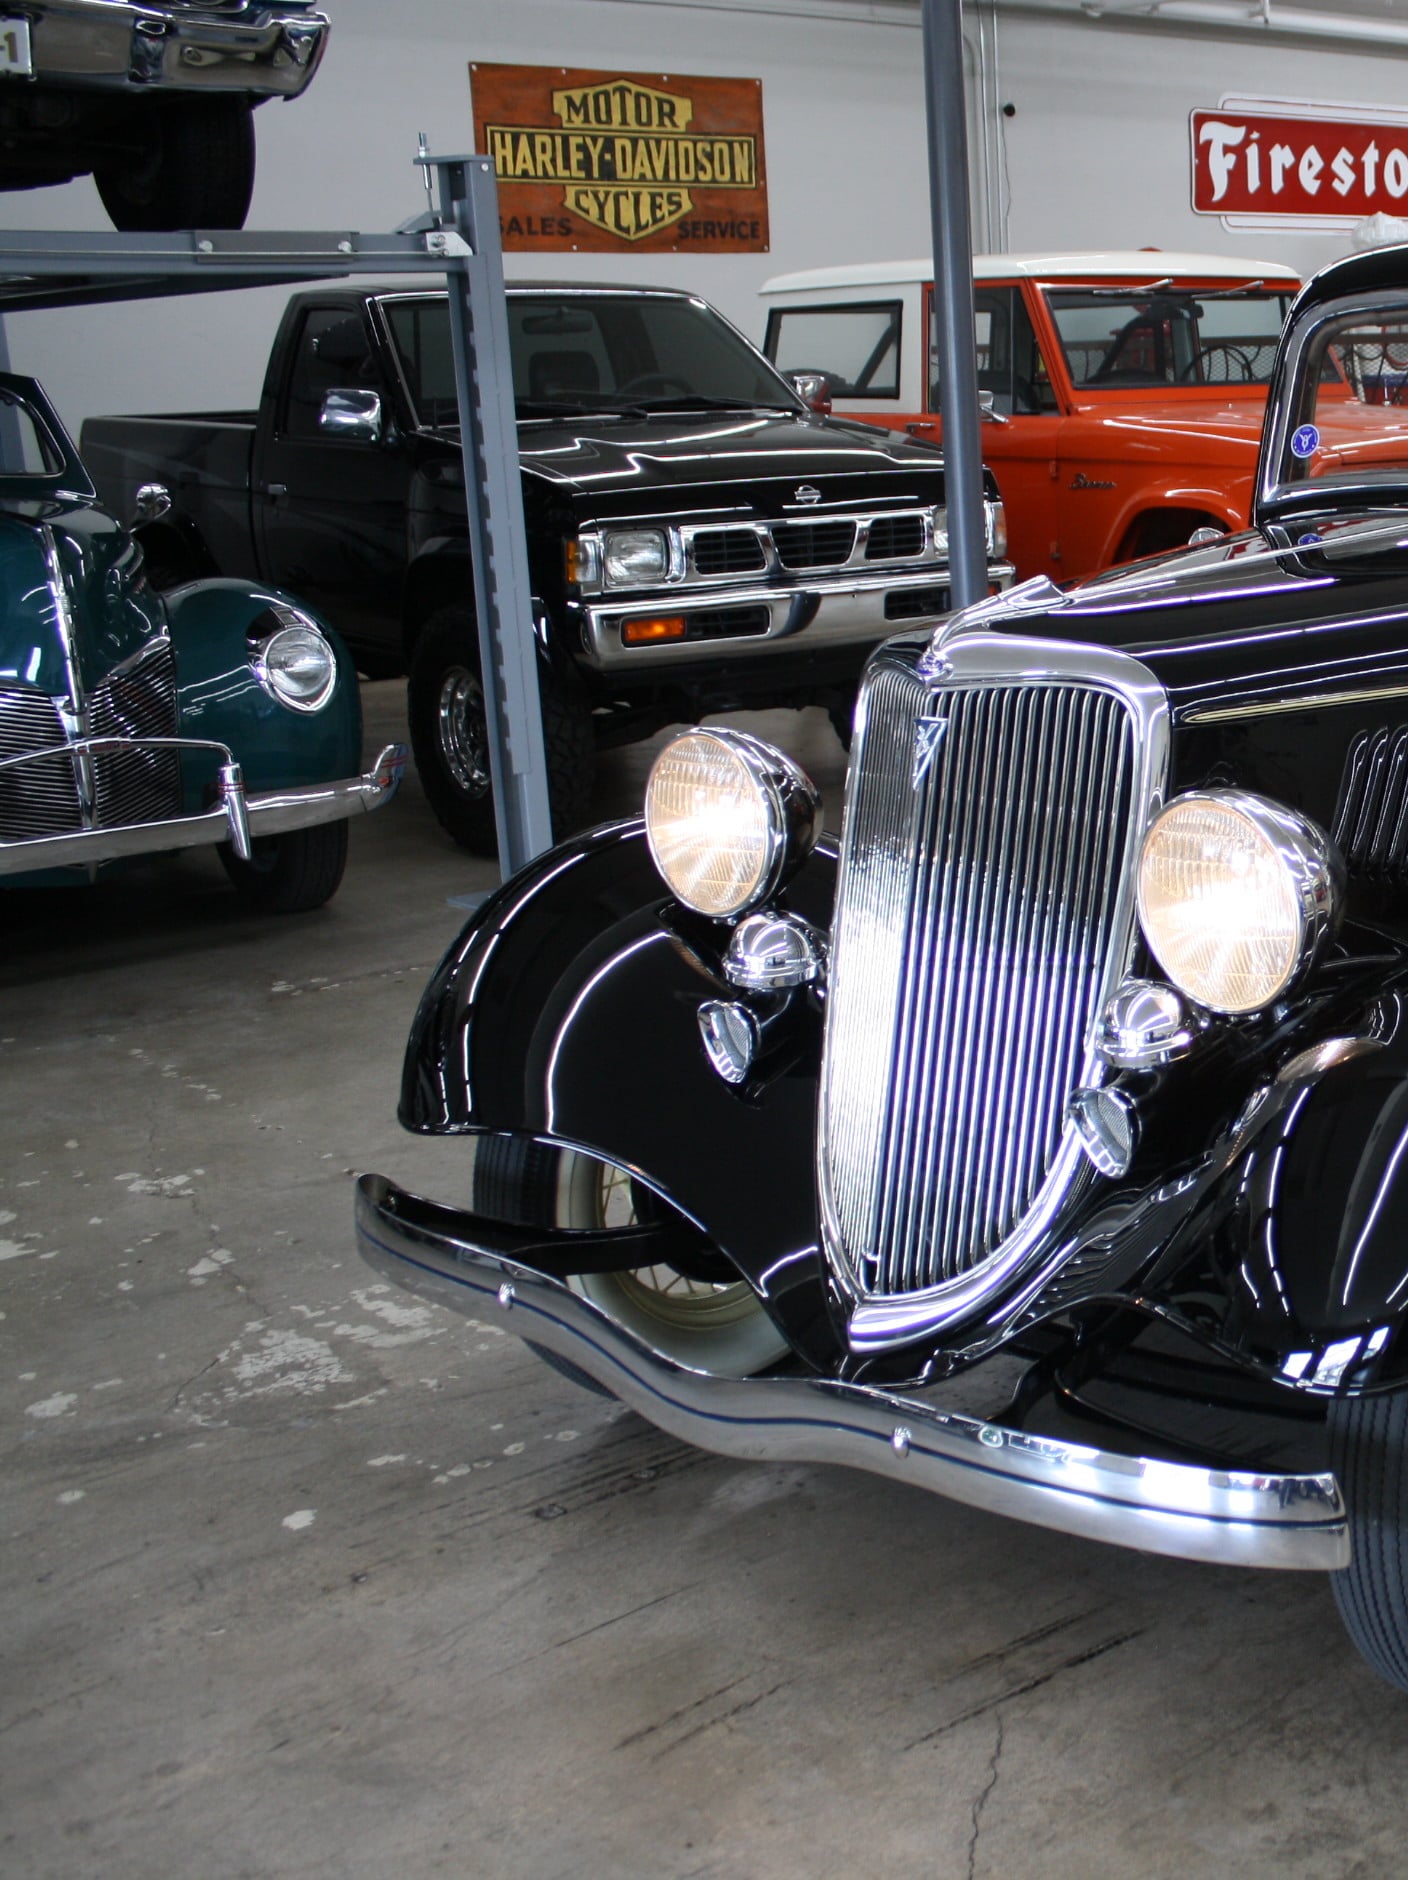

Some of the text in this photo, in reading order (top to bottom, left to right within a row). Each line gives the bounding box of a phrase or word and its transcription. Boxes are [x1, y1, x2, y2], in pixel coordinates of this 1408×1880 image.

[564, 86, 680, 128] MOTOR
[493, 132, 750, 183] HARLEY-DAVIDSON
[574, 188, 683, 235] CYCLES
[677, 220, 761, 240] SERVICE
